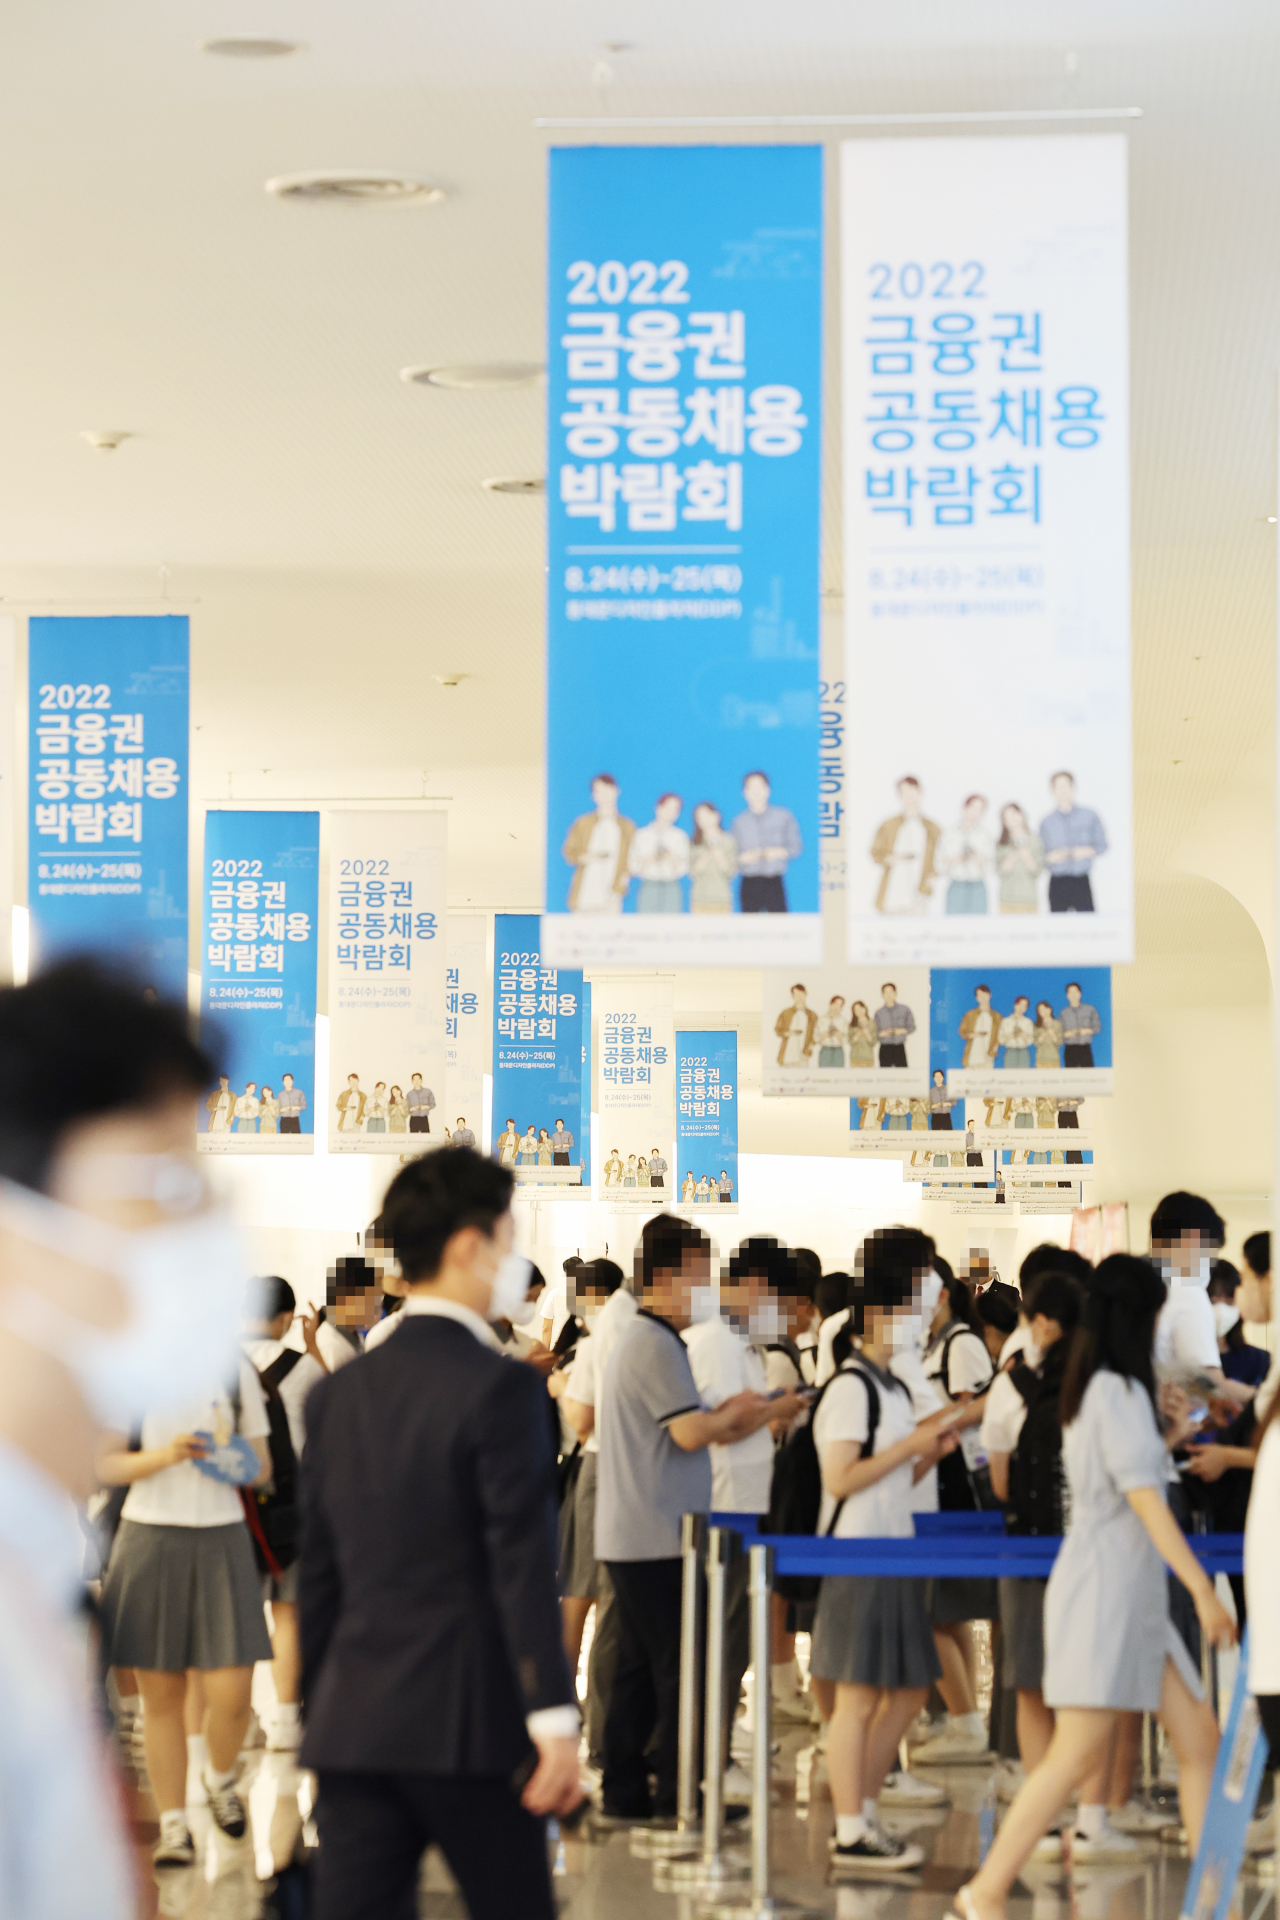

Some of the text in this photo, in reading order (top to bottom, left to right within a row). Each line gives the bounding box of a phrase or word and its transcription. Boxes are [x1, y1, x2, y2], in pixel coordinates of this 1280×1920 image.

[567, 260, 690, 304] 2022
[869, 260, 985, 300] 2022
[561, 310, 746, 382] 금융권
[866, 312, 1041, 376] 금융권
[561, 385, 808, 458] 공동채용
[867, 386, 1104, 453] 공동채용
[560, 460, 742, 532] 박람회
[866, 463, 1040, 526] 박람회
[39, 684, 111, 709] 2022
[819, 681, 844, 703] 22
[36, 713, 144, 755] 금융권
[36, 757, 180, 799] 공동채용
[35, 802, 142, 843] 박람회
[211, 860, 262, 877] 2022
[341, 860, 389, 875] 2022
[209, 881, 286, 909] 금융권
[339, 881, 412, 907] 금융권
[209, 912, 311, 941] 공동채용
[338, 913, 438, 939] 공동채용
[208, 944, 284, 972] 박람회
[338, 944, 410, 970] 박람회
[501, 953, 539, 966] 2022
[499, 969, 558, 991] 금융권
[447, 993, 478, 1014] 채용
[498, 994, 577, 1017] 공동채용
[498, 1018, 556, 1040] 박람회
[605, 1014, 636, 1023] 2022
[604, 1027, 651, 1044] 금융권
[499, 1052, 555, 1060] 8.24(수)~25(목)
[604, 1047, 668, 1064] 공동채용
[681, 1057, 707, 1066] 2022
[604, 1067, 650, 1084] 박람회
[680, 1068, 720, 1083] 금융권
[680, 1085, 734, 1101] 공동채용
[680, 1102, 719, 1117] 박람회
